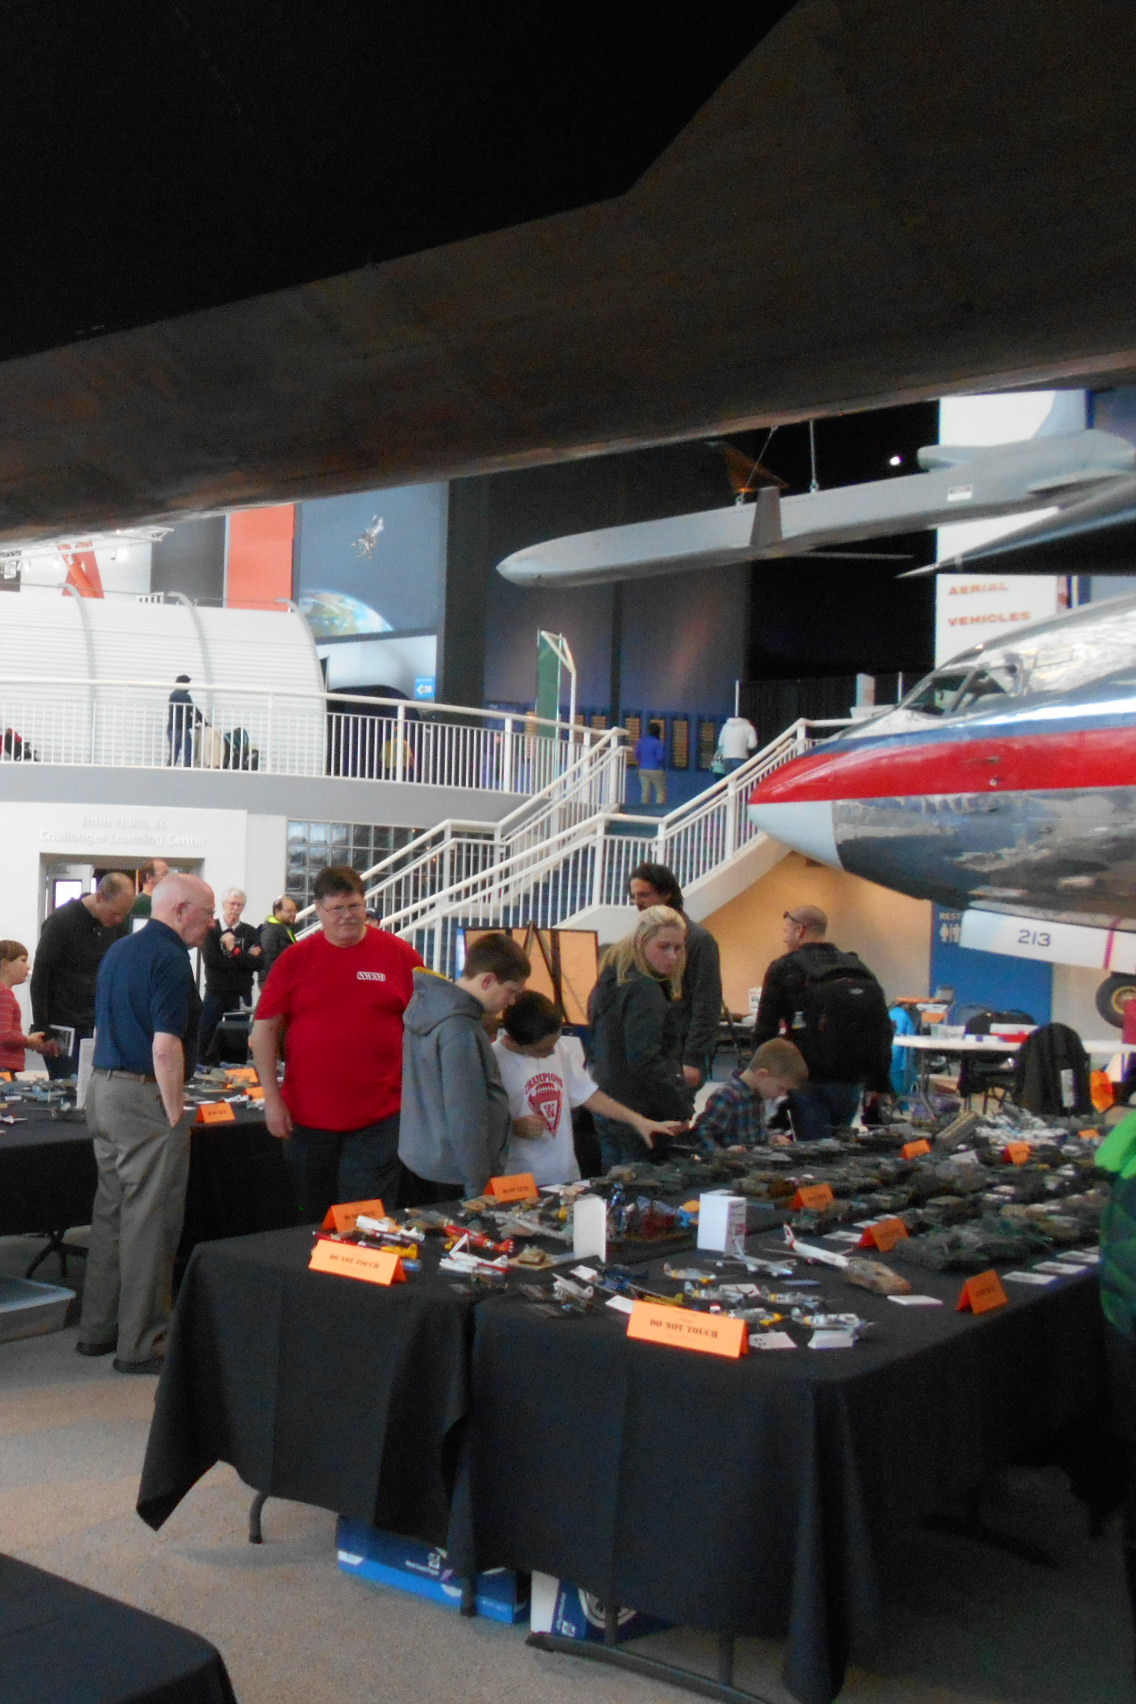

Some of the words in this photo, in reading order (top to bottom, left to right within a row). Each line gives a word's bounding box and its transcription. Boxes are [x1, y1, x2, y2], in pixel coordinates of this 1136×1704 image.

[948, 582, 1008, 596] AERIAL
[948, 610, 1031, 627] VEHICLES
[166, 833, 208, 848] Center
[1017, 929, 1052, 947] 213
[649, 1319, 663, 1328] DO
[665, 1321, 684, 1331] NOT
[687, 1325, 719, 1339] TOUCH
